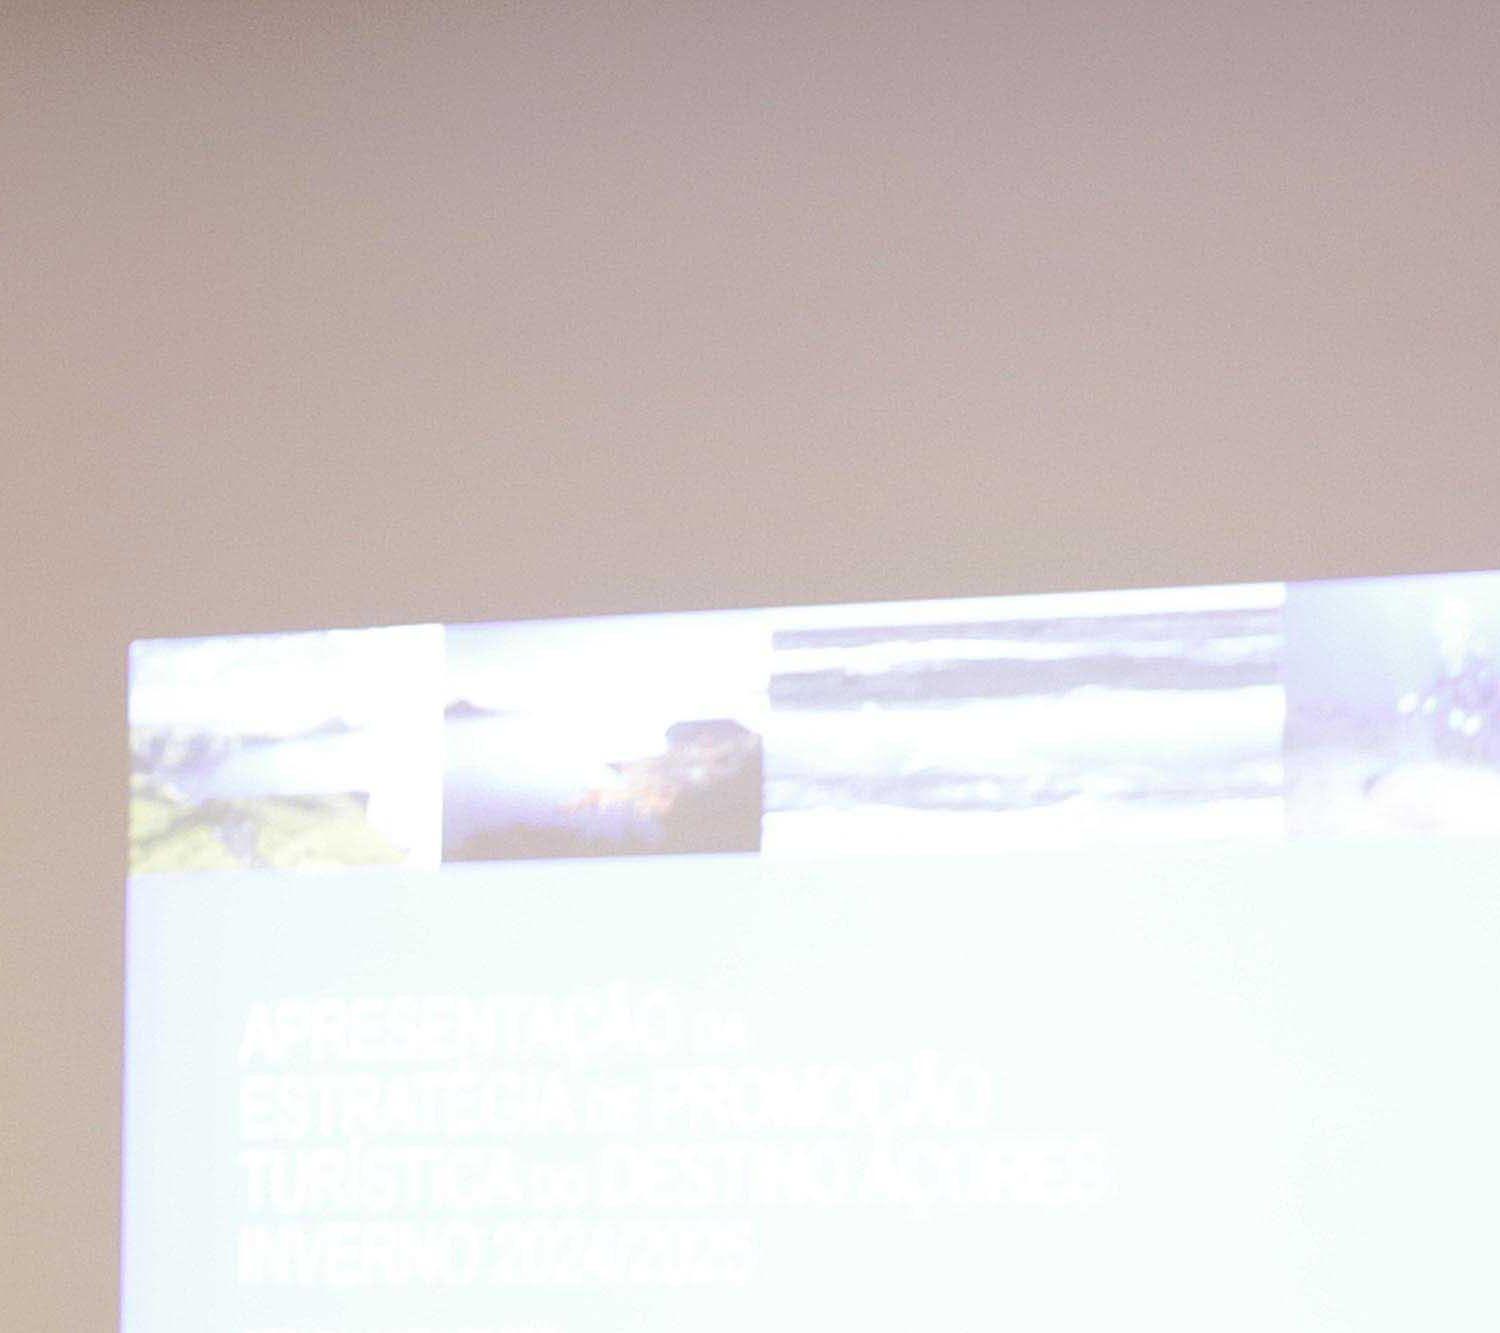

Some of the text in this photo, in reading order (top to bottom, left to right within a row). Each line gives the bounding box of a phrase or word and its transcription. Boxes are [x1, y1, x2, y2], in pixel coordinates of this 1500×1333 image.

[238, 980, 681, 1066] APRESENTAÇÃO
[239, 1062, 574, 1140] ESTRATÉGIA
[651, 1043, 993, 1140] PROMOÇÃO
[239, 1138, 522, 1213] TURÍSTICA
[598, 1144, 850, 1206] DESTINO
[859, 1136, 1112, 1220] AÇORES
[239, 1222, 481, 1285] INVERNO
